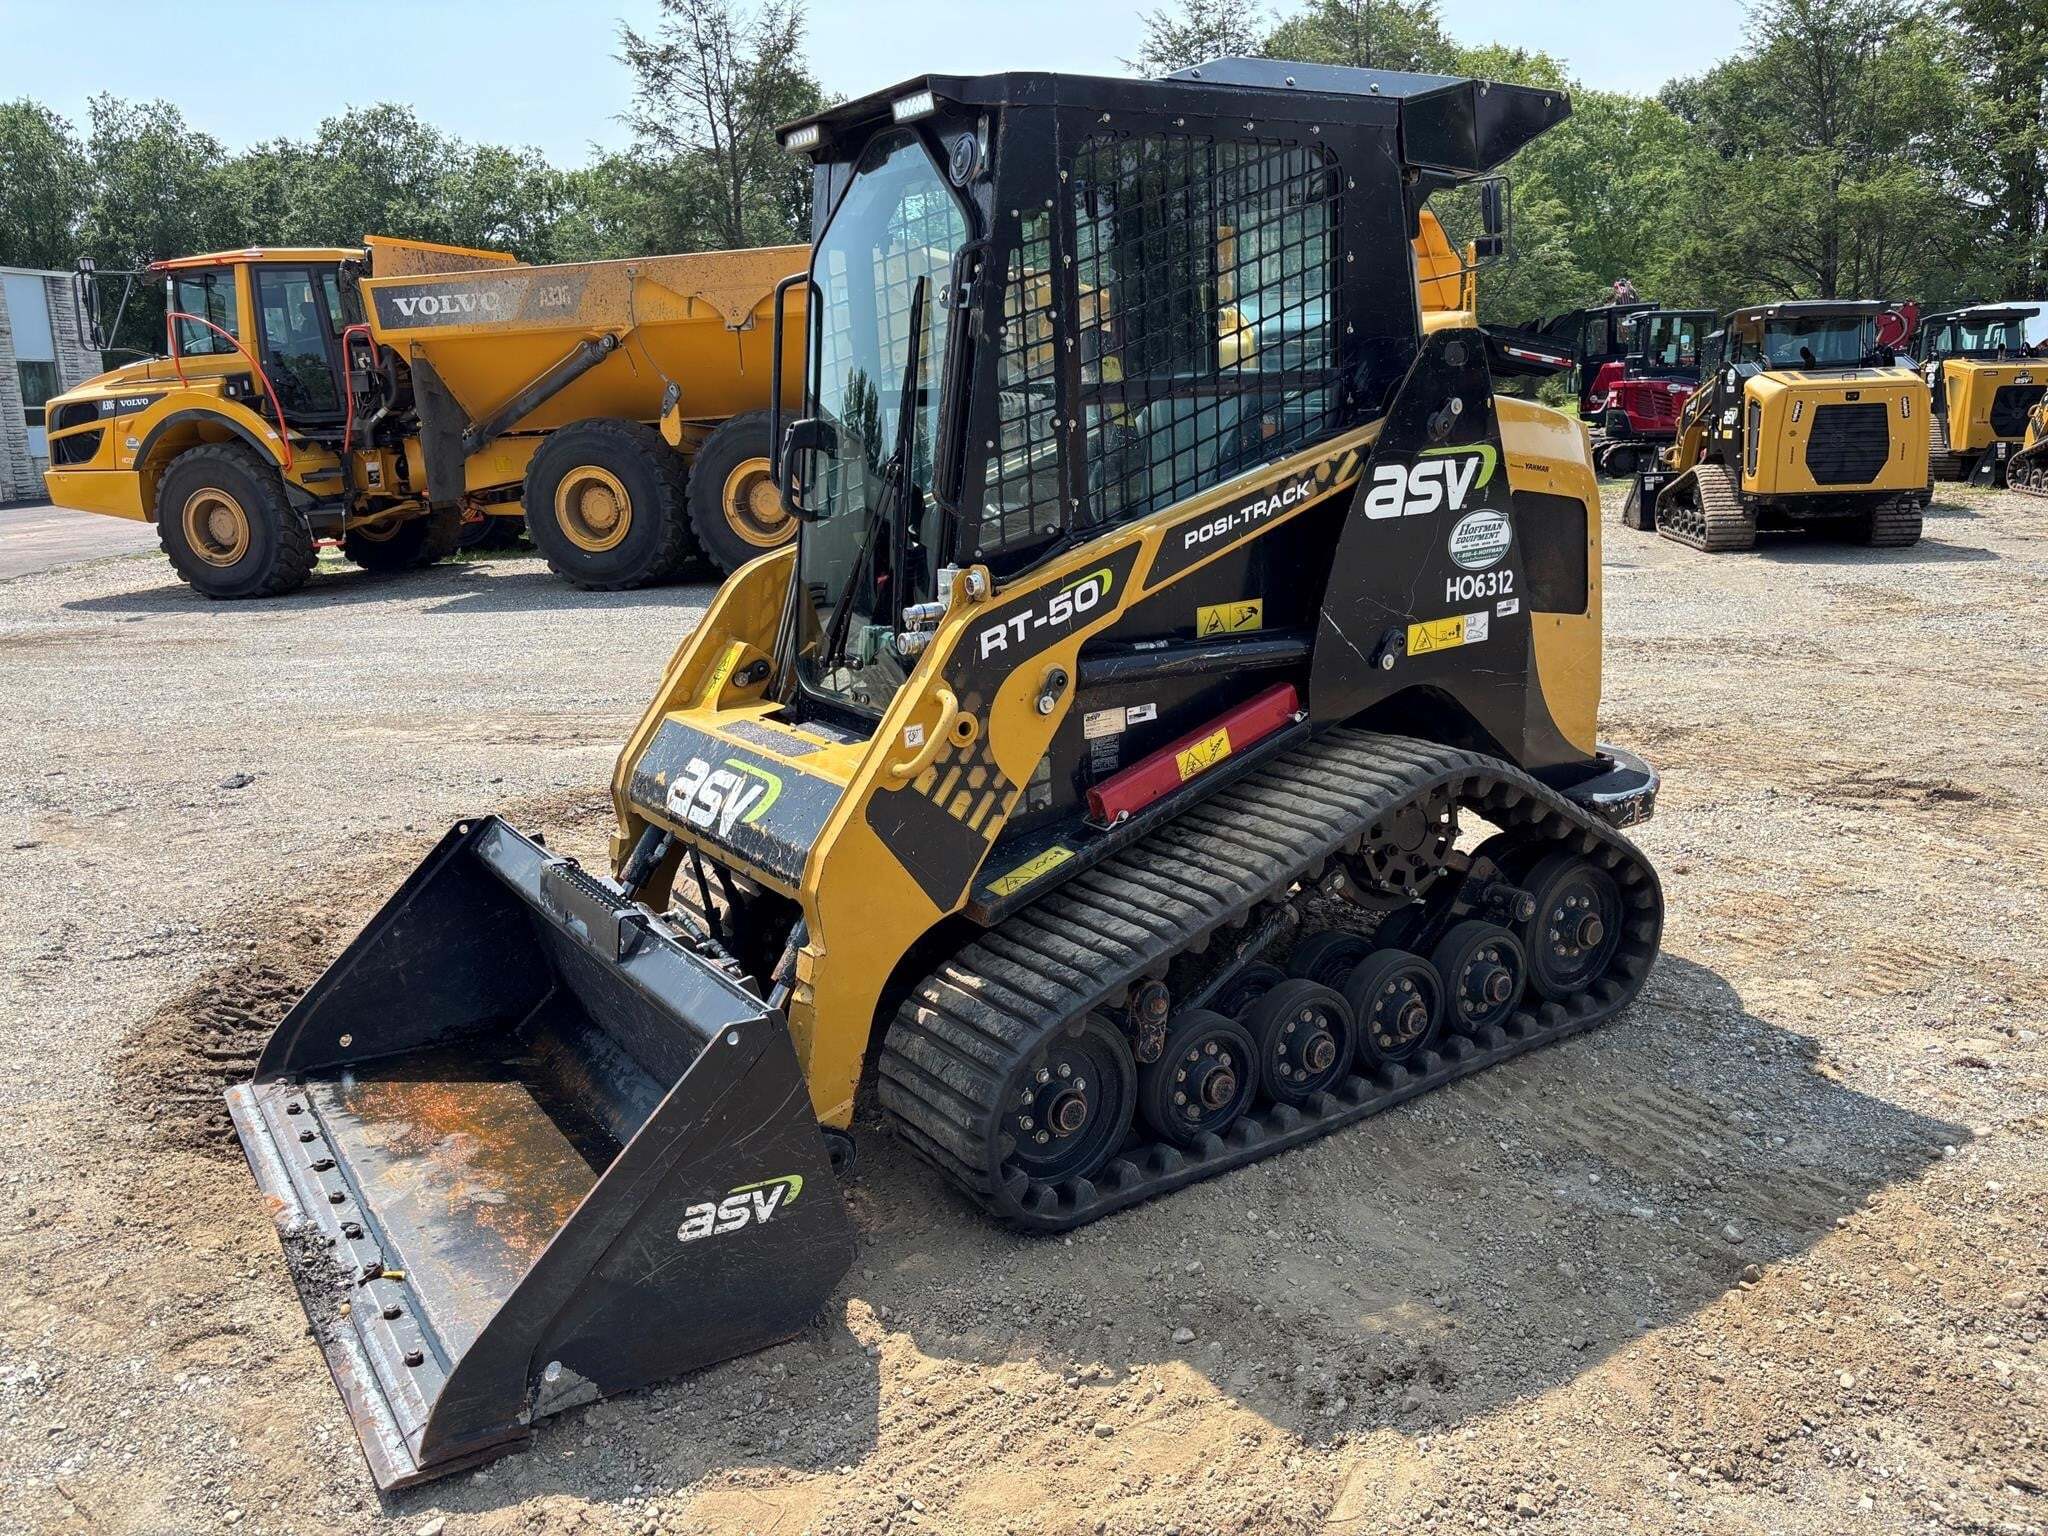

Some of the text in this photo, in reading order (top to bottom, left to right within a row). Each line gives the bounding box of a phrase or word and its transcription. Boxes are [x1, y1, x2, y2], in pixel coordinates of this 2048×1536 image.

[393, 292, 500, 317] VOLVO
[120, 398, 149, 407] VOLVO
[1364, 456, 1480, 520] asv
[1525, 463, 1550, 473] YANMAR
[1184, 480, 1310, 550] POSI-TRACK
[1458, 522, 1504, 536] HOFFMAN
[1455, 531, 1501, 545] EQUIPMENT
[980, 579, 1098, 660] RT-50
[666, 757, 765, 838] asv
[677, 1183, 786, 1242] asv
